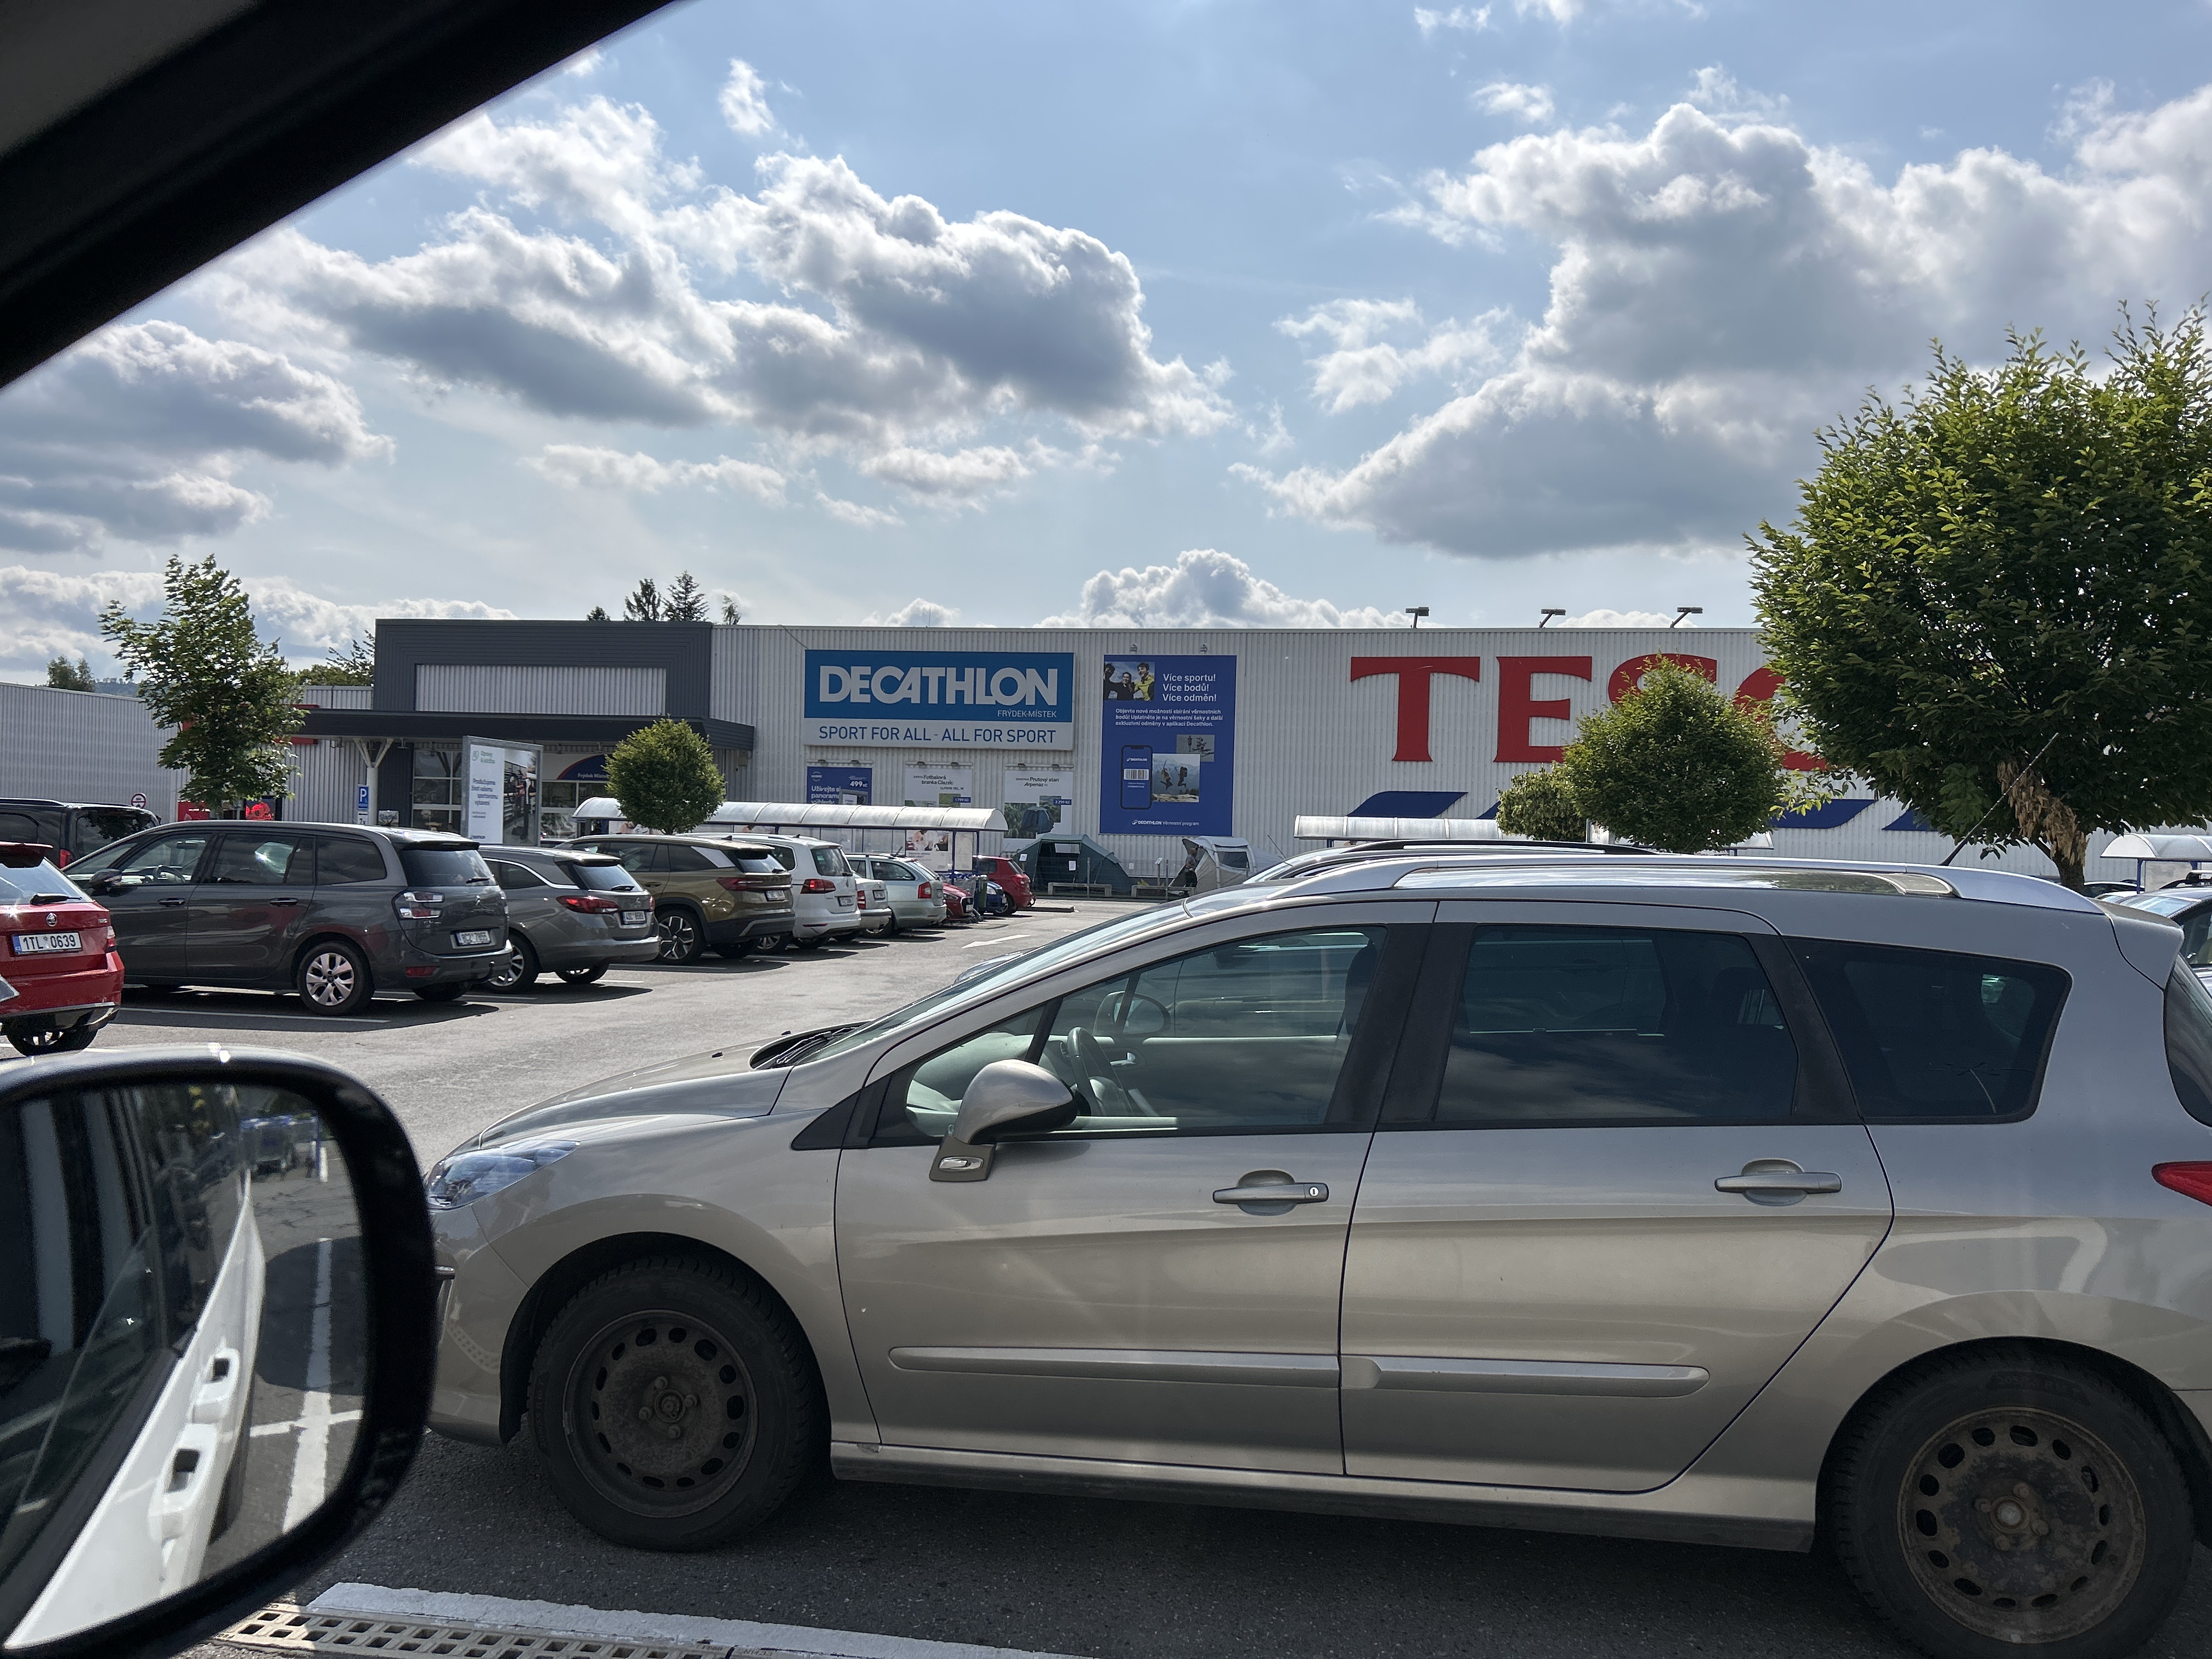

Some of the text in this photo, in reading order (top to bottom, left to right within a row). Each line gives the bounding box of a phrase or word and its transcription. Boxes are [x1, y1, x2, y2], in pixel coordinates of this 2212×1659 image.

[1163, 673, 1216, 683] Více sportu!
[819, 665, 1058, 706] DECATHLON
[1184, 683, 1209, 691] bodů!
[997, 709, 1057, 718] FRÝDEK-MÍSTEK
[819, 726, 867, 740] SPORT
[872, 727, 900, 740] FOR
[904, 728, 932, 741] ALL
[941, 729, 969, 741] ALL
[974, 729, 1003, 742] FOR
[1007, 730, 1056, 743] SPORT
[360, 788, 367, 802] P
[23, 934, 76, 950] 1TL 0639
